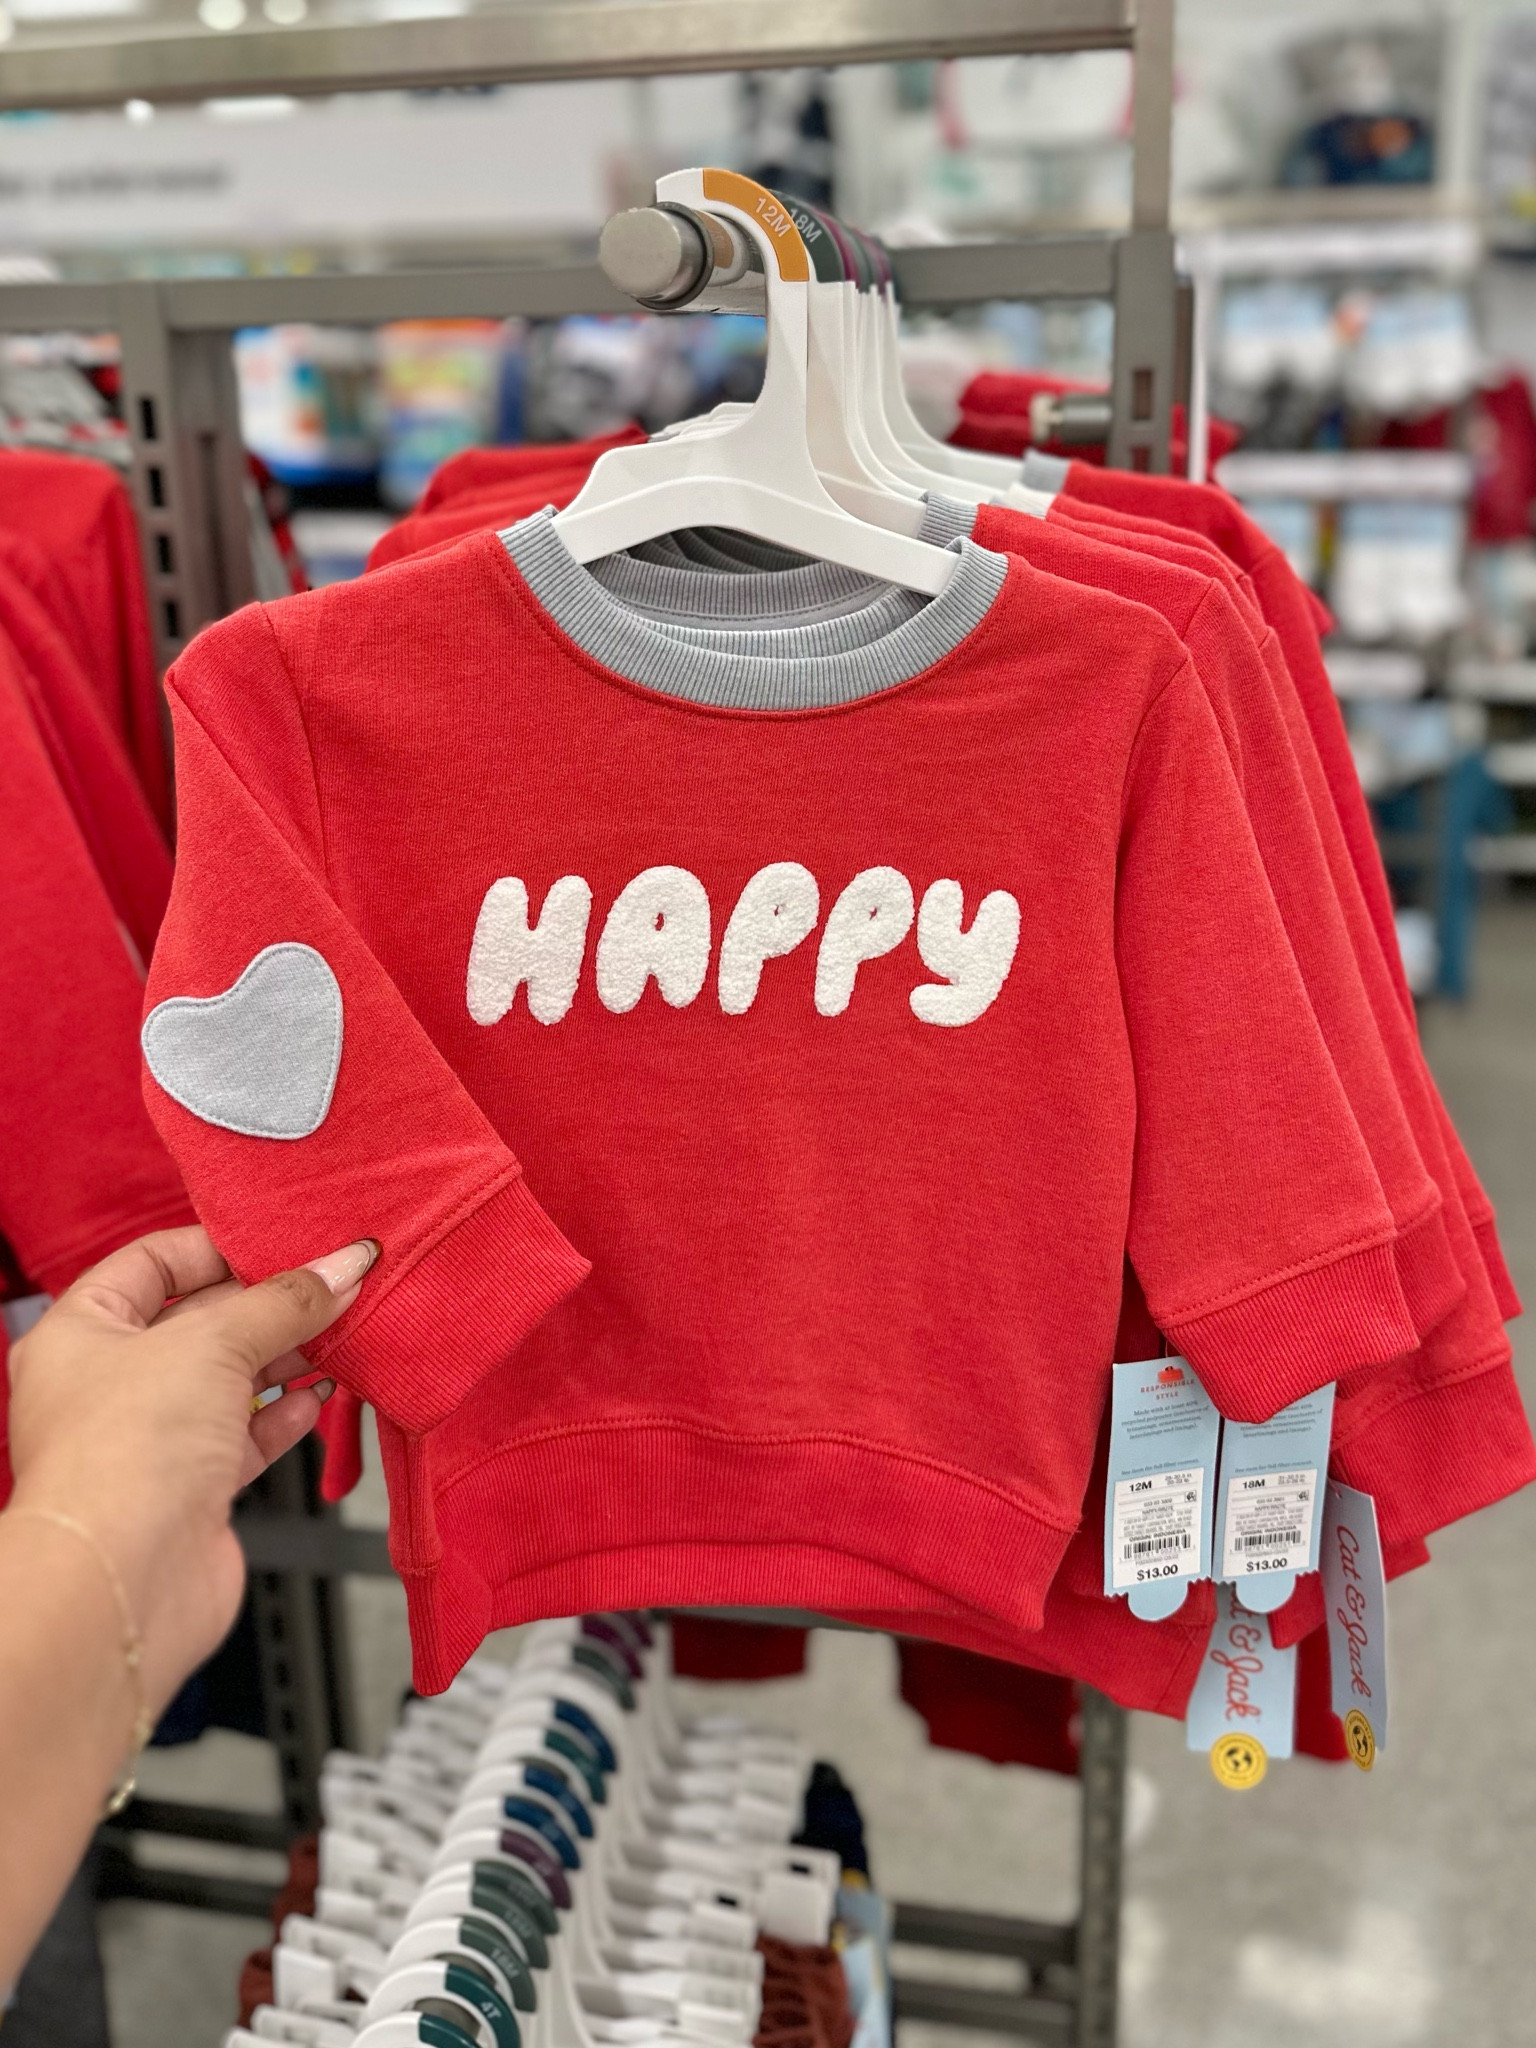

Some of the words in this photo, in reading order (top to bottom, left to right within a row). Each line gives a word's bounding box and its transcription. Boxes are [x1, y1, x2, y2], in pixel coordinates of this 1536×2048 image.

[756, 197, 792, 238] 12M
[789, 208, 823, 243] 18M
[466, 861, 1022, 1027] HAPPY
[1140, 1379, 1195, 1393] RESPONSIBLE
[1156, 1391, 1179, 1400] STYLE
[1129, 1480, 1153, 1492] 12M
[1242, 1478, 1266, 1489] 18M
[1336, 1524, 1361, 1586] Cat
[1136, 1564, 1179, 1581] $13.00
[1245, 1557, 1288, 1573] $13.00
[1337, 1608, 1372, 1699] Jack
[1210, 1649, 1264, 1722] Jack
[479, 2001, 503, 2020] 4T
